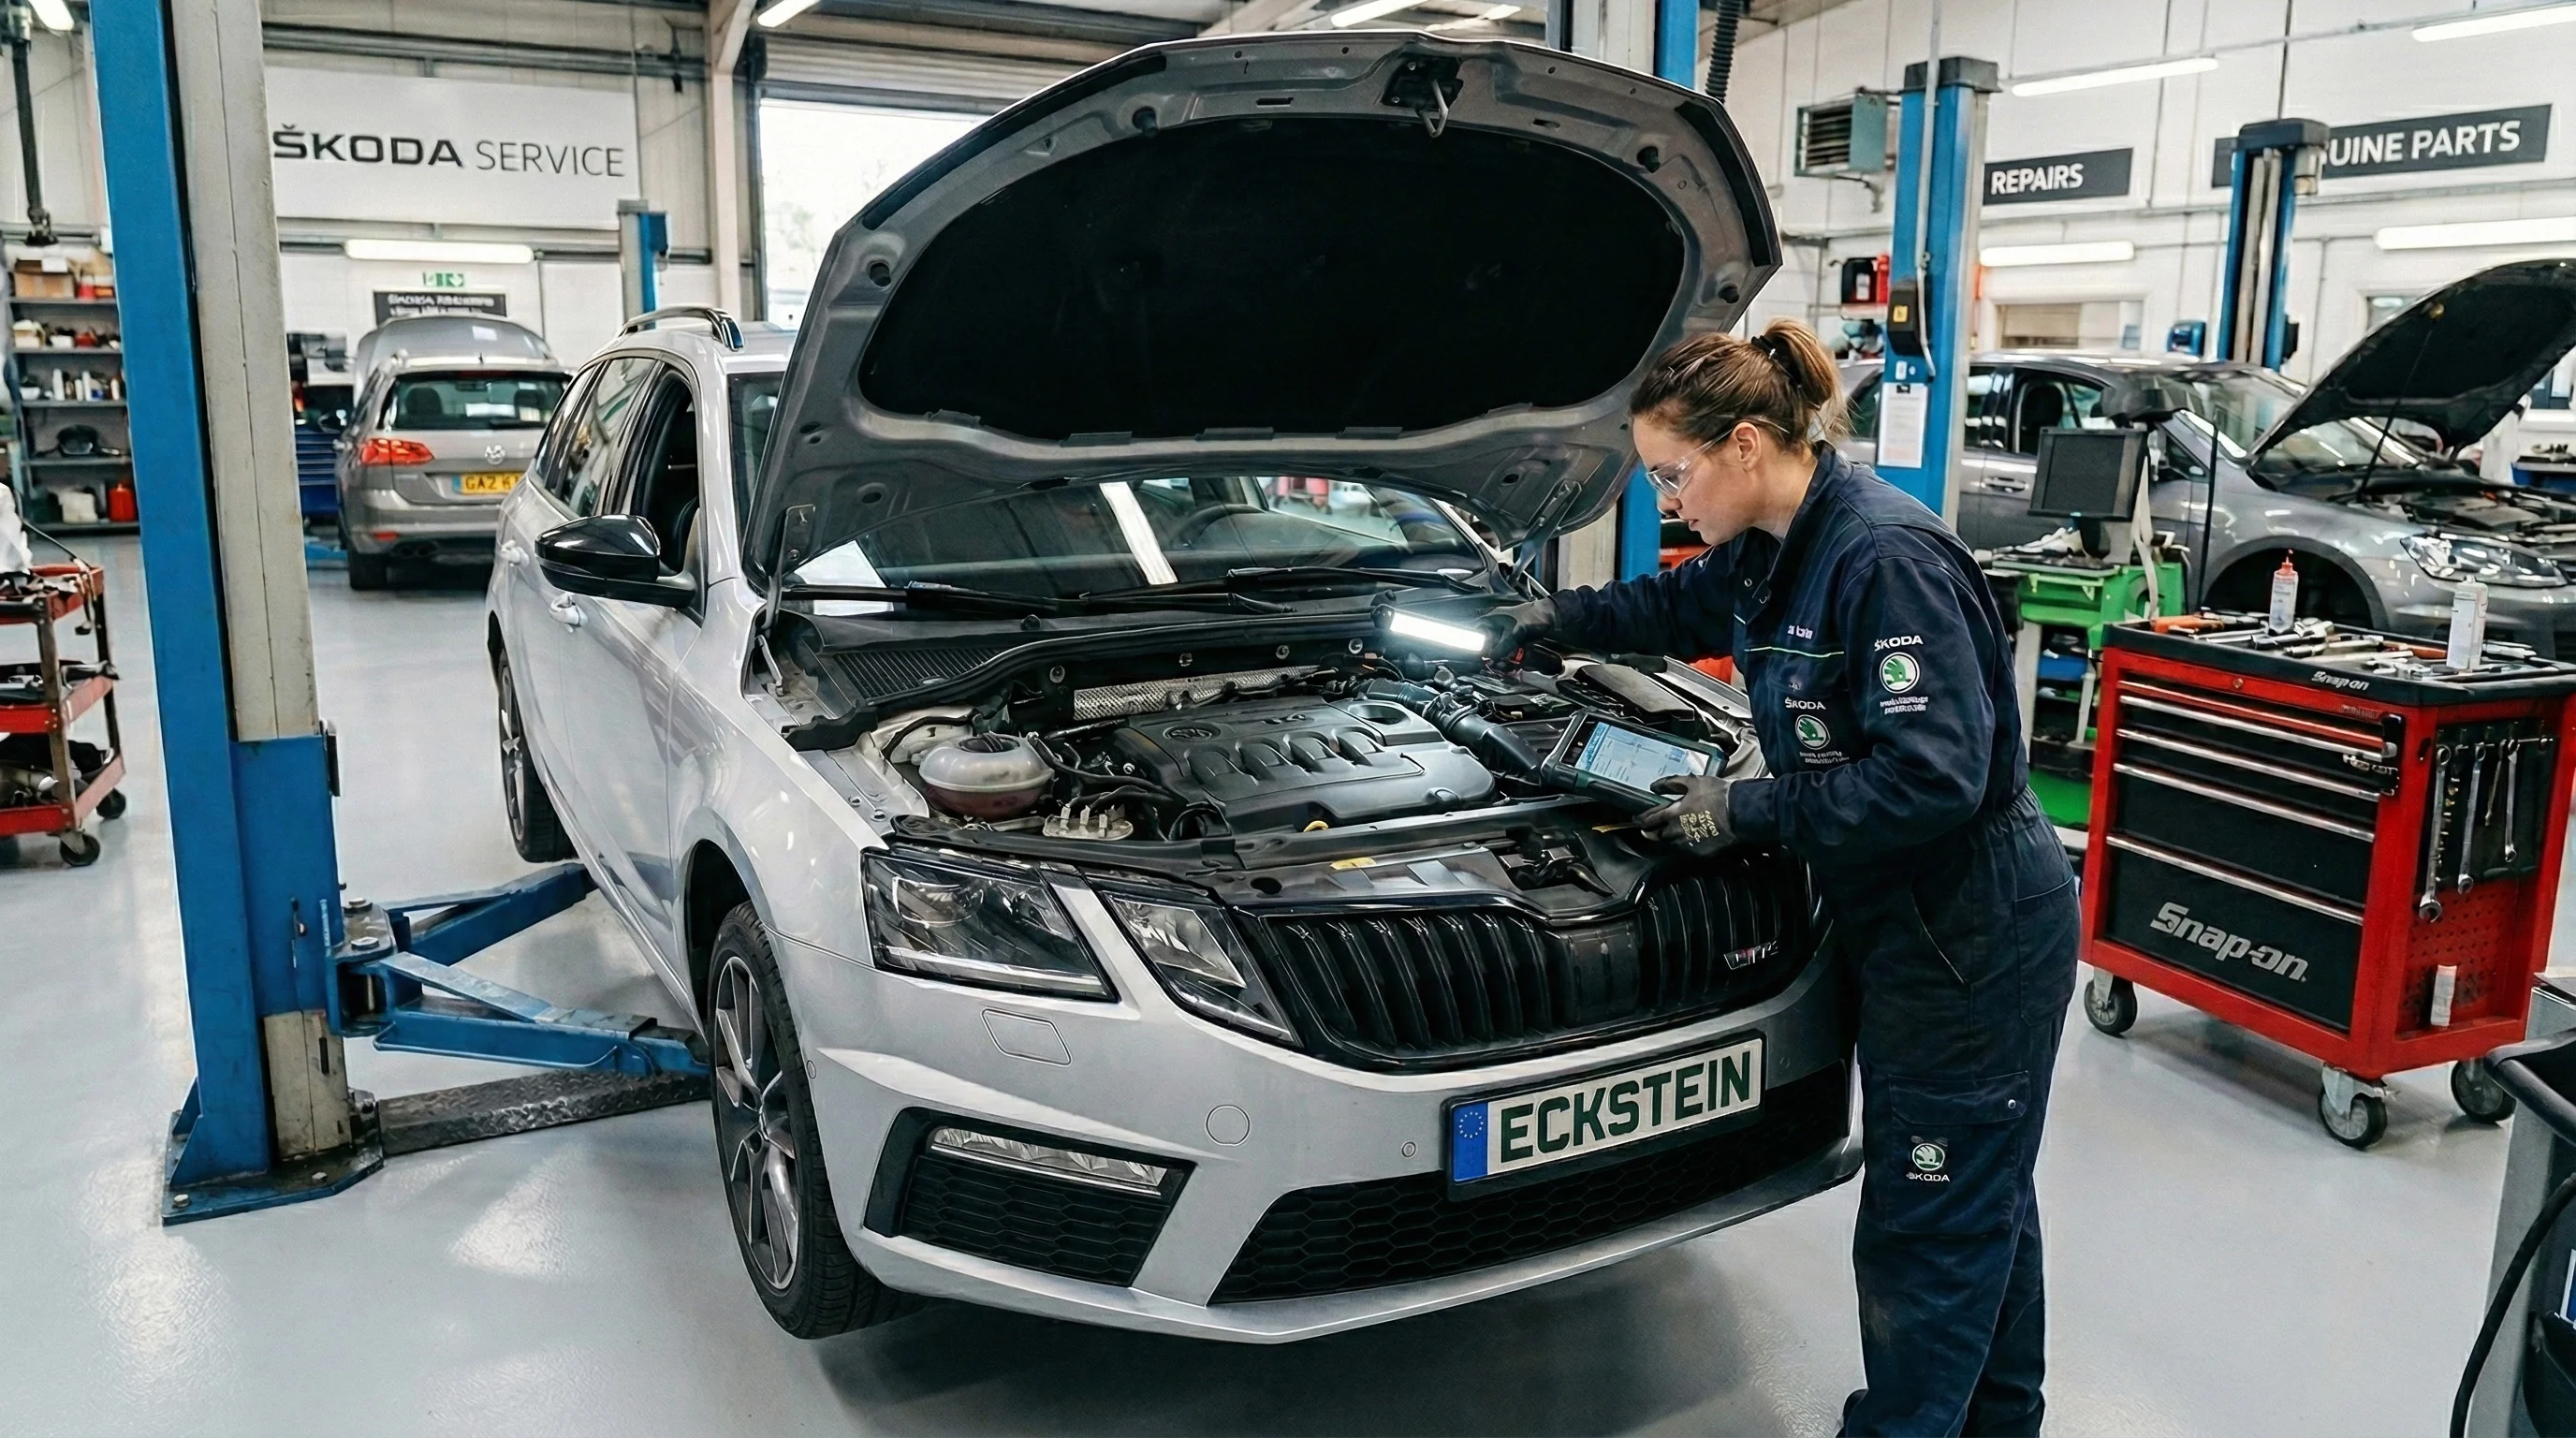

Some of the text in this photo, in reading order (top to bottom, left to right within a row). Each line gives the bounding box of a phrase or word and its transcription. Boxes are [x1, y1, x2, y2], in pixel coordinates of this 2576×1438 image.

[272, 124, 626, 177] ŠKODA SERVICE
[2322, 120, 2522, 168] UINE PARTS
[1990, 162, 2085, 196] REPAIRS
[1874, 635, 1925, 652] ŠKODA
[2149, 902, 2308, 983] Snap-on
[1500, 1050, 1751, 1164] ECKSTEIN
